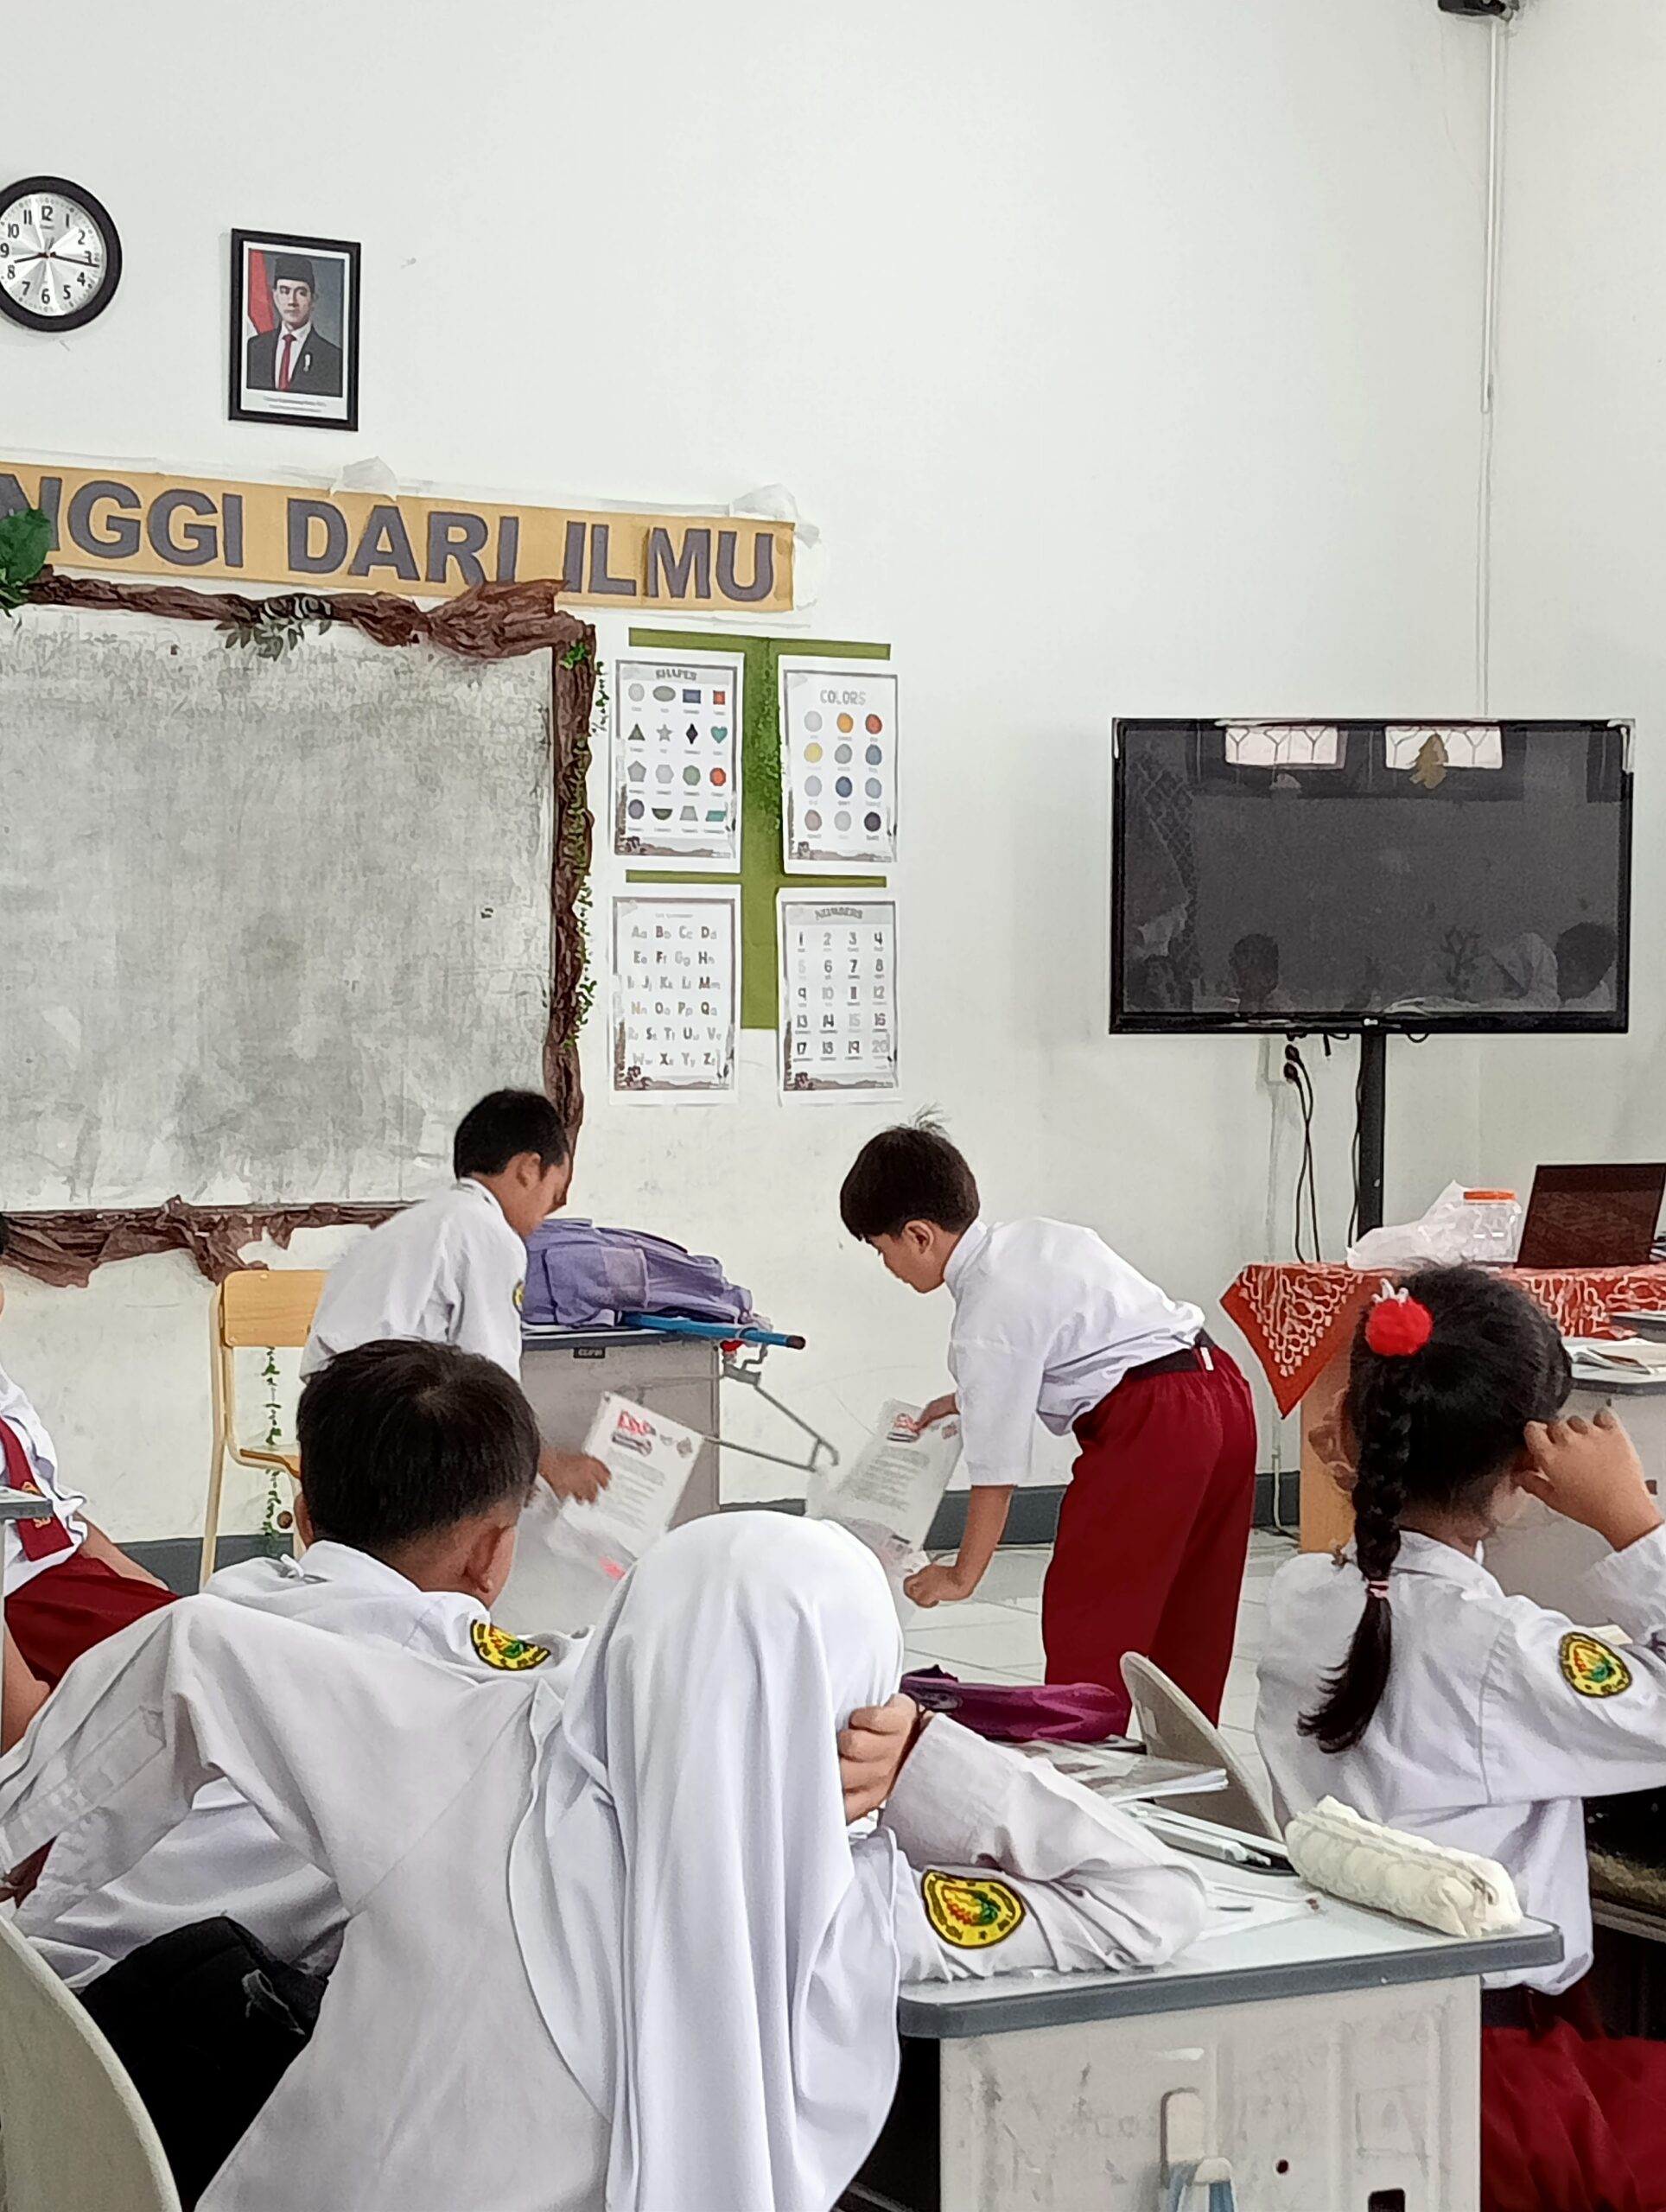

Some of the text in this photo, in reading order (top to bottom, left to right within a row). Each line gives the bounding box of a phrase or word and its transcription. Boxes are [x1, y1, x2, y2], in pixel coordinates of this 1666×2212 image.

[23, 209, 32, 225] 11
[41, 206, 53, 221] 12
[66, 213, 70, 228] 1
[8, 223, 19, 238] 10
[78, 229, 86, 245] 2
[0, 243, 10, 258] 9
[8, 264, 16, 279] 8
[77, 272, 86, 287] 4
[22, 281, 30, 296] 7
[63, 285, 71, 300] 5
[41, 289, 50, 304] 6
[287, 498, 519, 588] DARI
[562, 520, 774, 601] ILMU
[820, 690, 866, 705] COLORS
[823, 932, 831, 945] 2
[849, 932, 856, 944] 3
[874, 931, 883, 944] 4
[824, 960, 832, 973] 6
[849, 959, 857, 973] 7
[875, 958, 883, 972] 8
[798, 988, 806, 1001] 9
[823, 987, 834, 1000] 10
[874, 986, 885, 999] 12
[823, 1014, 834, 1027] 14
[874, 1013, 886, 1026] 16
[849, 1041, 860, 1054] 19
[872, 1039, 888, 1052] 20
